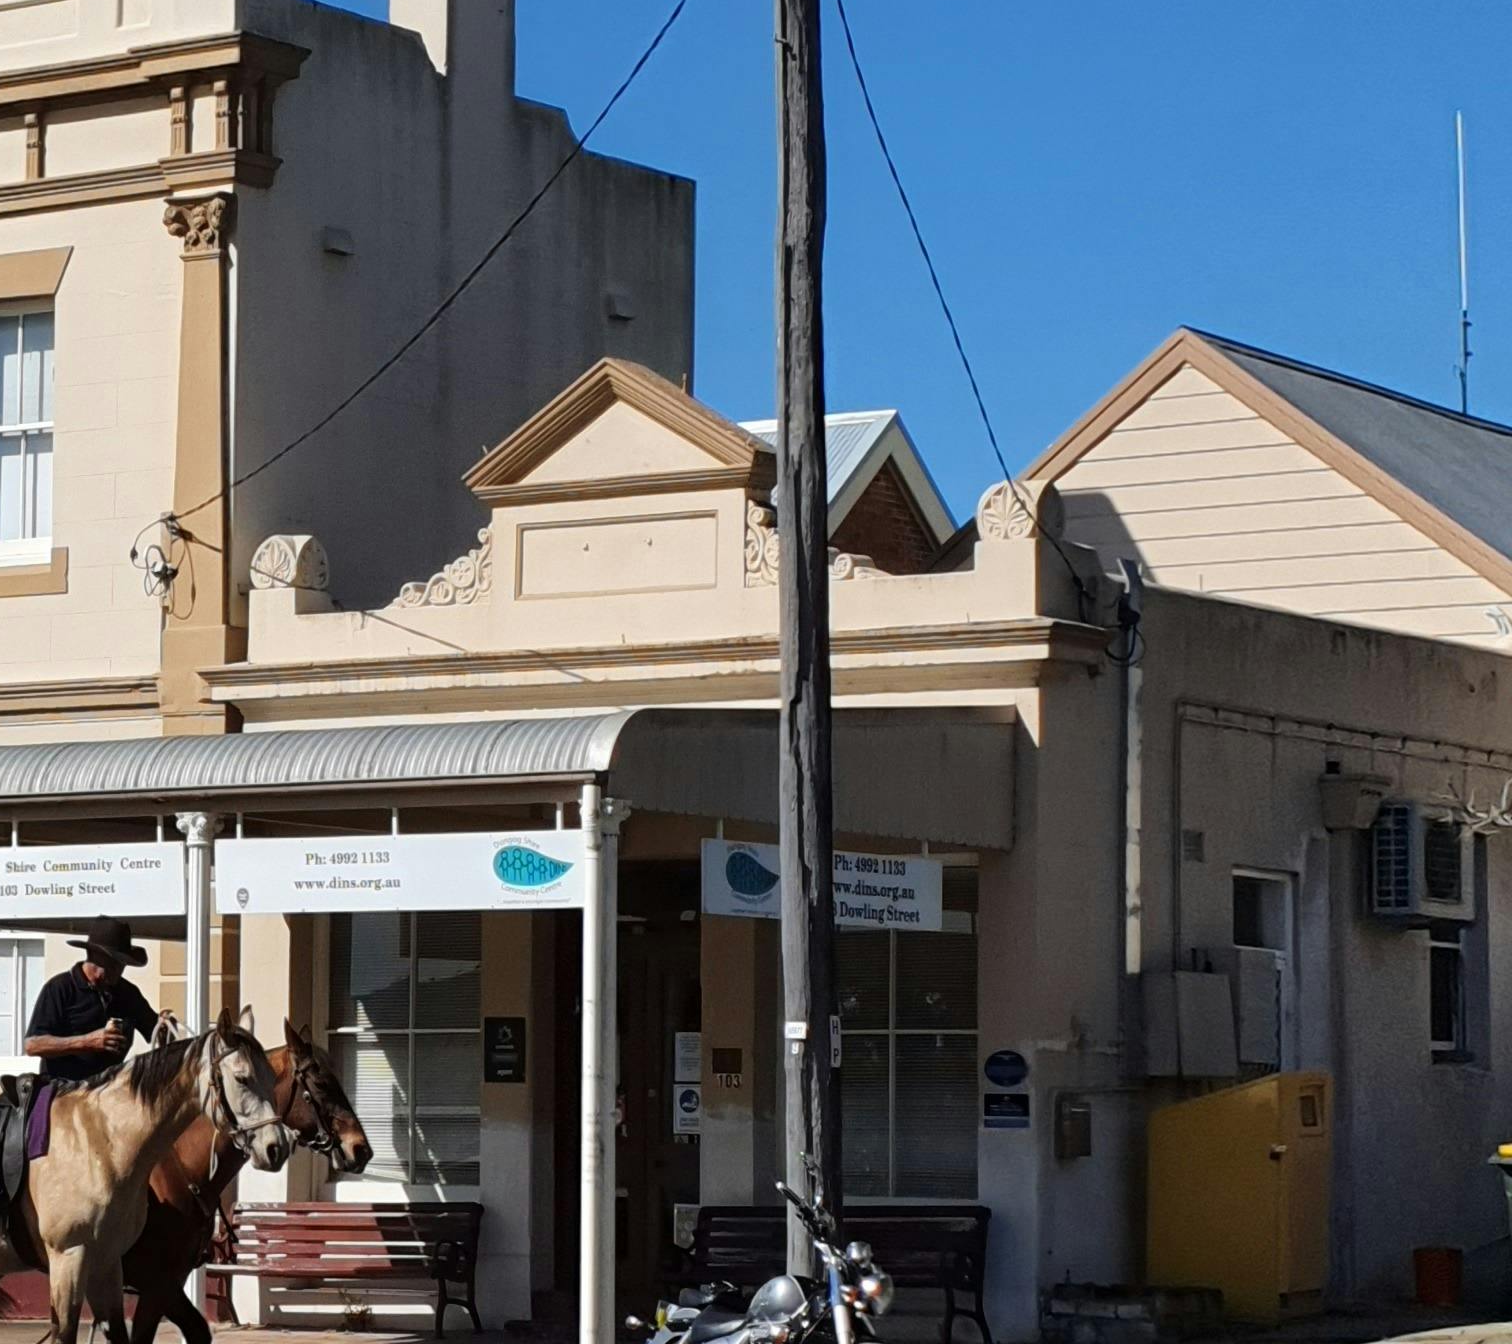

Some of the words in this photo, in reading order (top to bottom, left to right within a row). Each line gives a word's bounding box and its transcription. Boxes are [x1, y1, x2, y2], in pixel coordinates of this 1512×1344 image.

[5, 861, 36, 873] Shire
[43, 857, 113, 873] Community
[120, 857, 162, 870] Centre
[305, 853, 327, 866] Ph:
[329, 853, 358, 865] 4992
[361, 851, 390, 864] 1133
[833, 854, 853, 872] Ph:
[854, 857, 879, 874] 4992
[881, 859, 906, 876] 1133
[0, 884, 18, 897] 103
[24, 883, 74, 897] Dowling
[78, 882, 116, 896] Street
[294, 875, 401, 890] www.dins.org.au
[832, 879, 915, 902] ww.dins.org.au
[839, 901, 886, 925] Dowling
[886, 904, 921, 924] Street
[717, 1074, 742, 1089] 103
